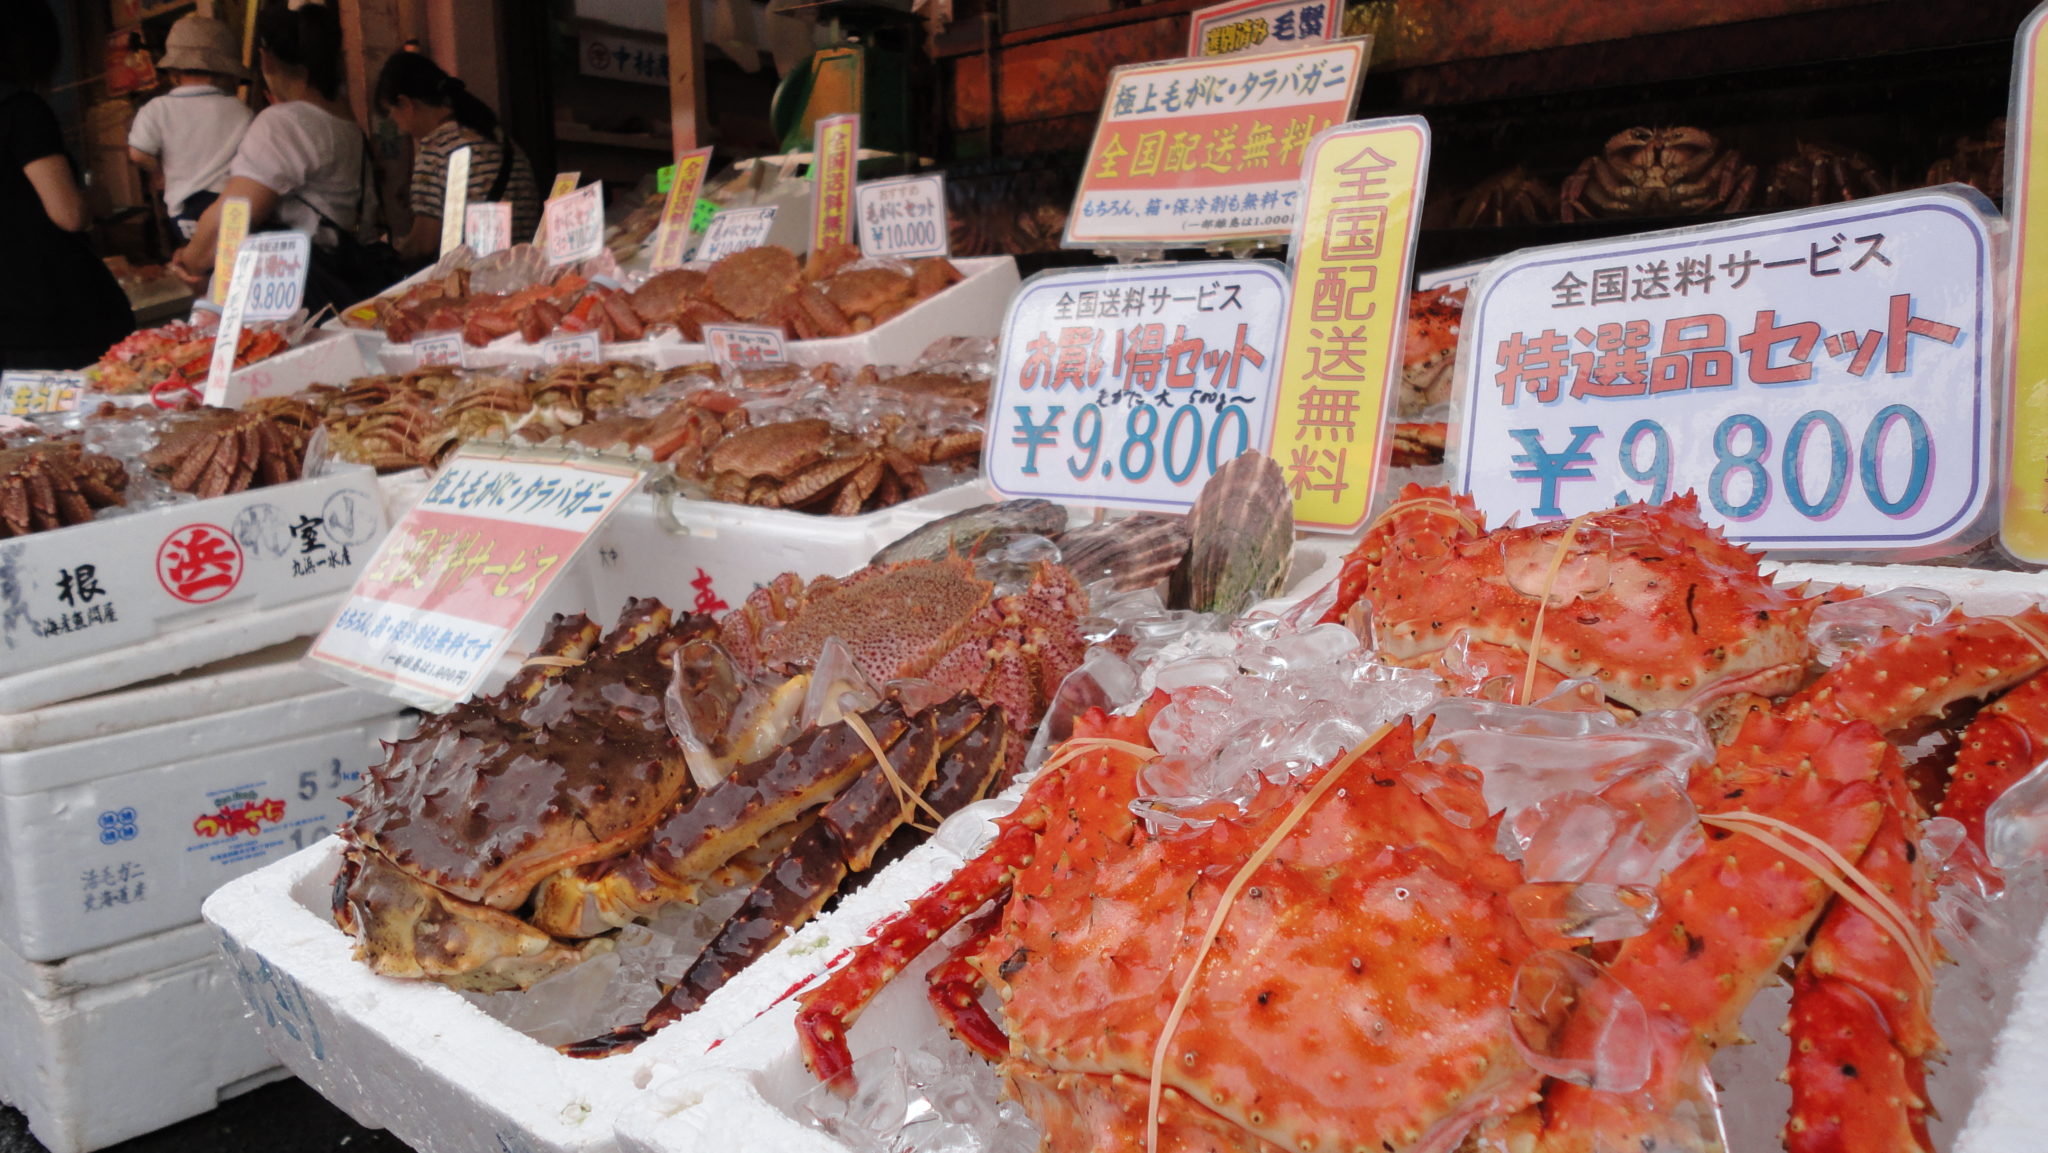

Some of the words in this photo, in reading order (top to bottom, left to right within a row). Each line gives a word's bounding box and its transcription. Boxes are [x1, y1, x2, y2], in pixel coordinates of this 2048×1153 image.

[1206, 17, 1269, 56] 選別済み
[1272, 4, 1325, 40] 毛蟹
[1112, 59, 1346, 117] 極上毛がに・タラバガニ
[1055, 284, 1243, 320] 全国送料サービス
[1551, 231, 1892, 309] 全国送料サービス
[1019, 323, 1266, 393] お買い得セット
[1288, 146, 1397, 504] 全国配送無料
[1494, 293, 1962, 406] 特選品セット
[1011, 402, 1251, 487] ¥9.800
[1508, 404, 1936, 521] ¥9800
[55, 562, 107, 608] 根
[288, 513, 327, 554] 室
